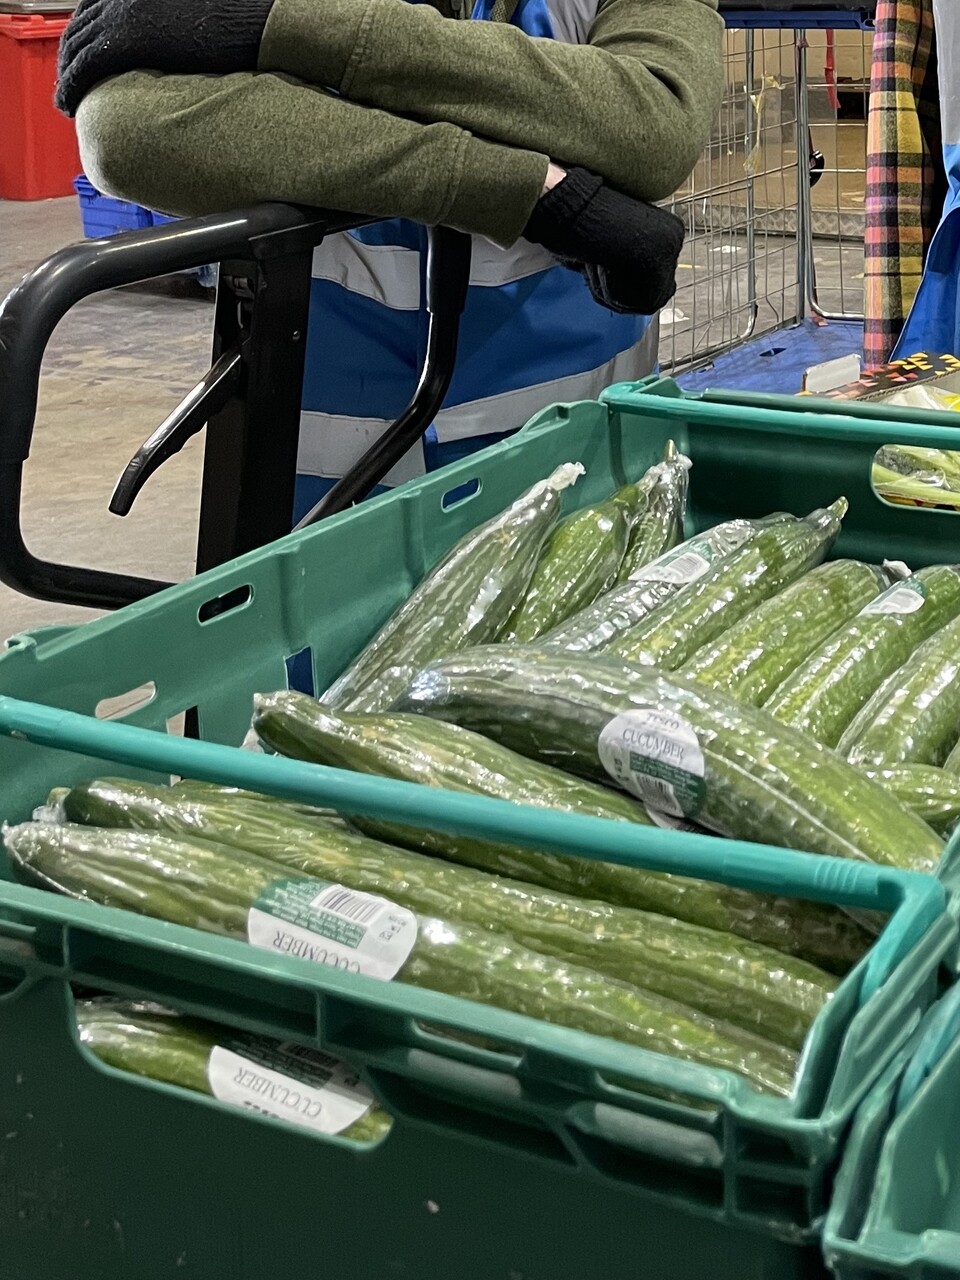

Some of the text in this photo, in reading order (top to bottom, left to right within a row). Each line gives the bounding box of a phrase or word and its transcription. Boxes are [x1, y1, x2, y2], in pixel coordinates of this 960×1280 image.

[622, 727, 684, 760] CUCUMBER
[272, 930, 361, 973] CUCUMBER
[233, 1067, 323, 1118] CUCUMBER
